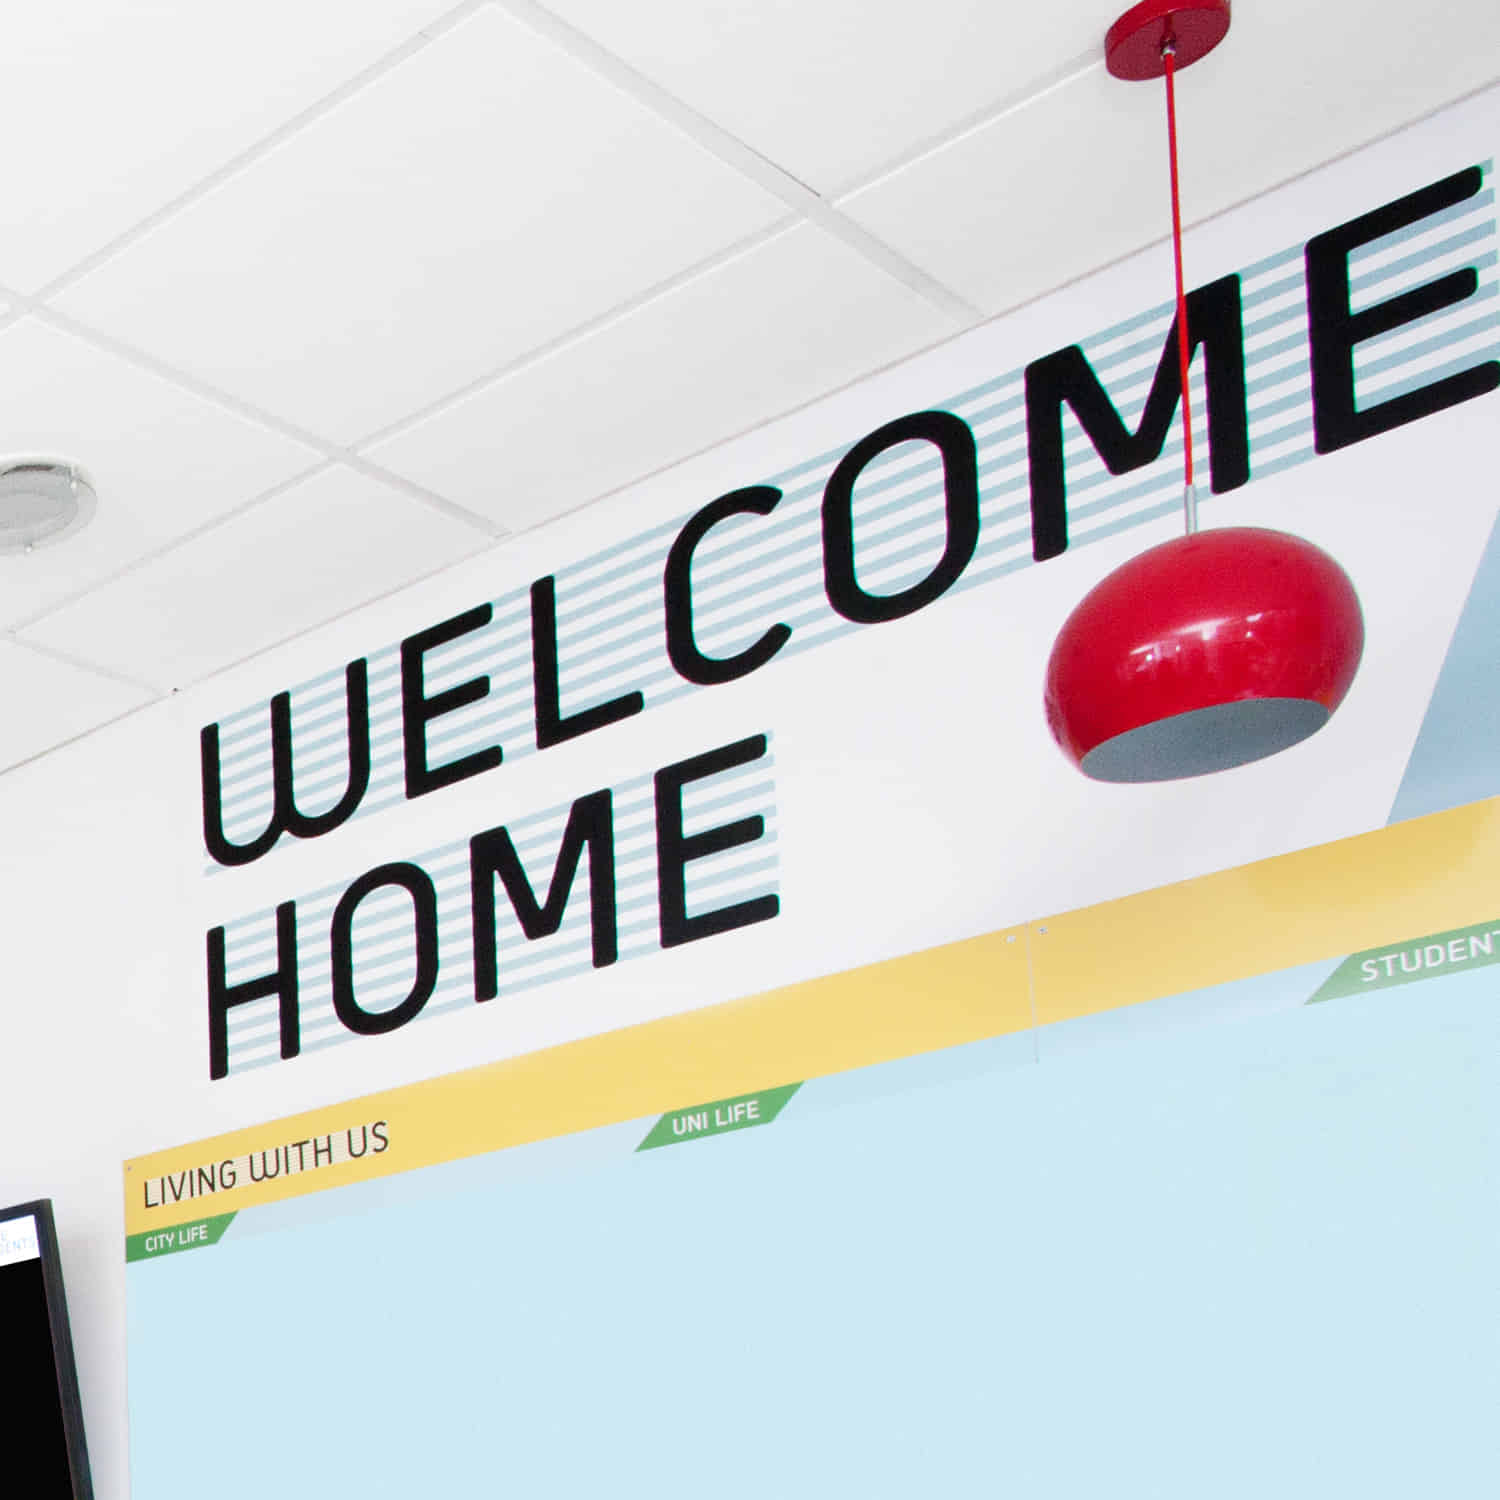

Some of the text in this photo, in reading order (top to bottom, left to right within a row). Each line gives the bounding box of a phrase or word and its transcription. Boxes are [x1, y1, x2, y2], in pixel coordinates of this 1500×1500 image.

[202, 167, 1500, 865] WELCOME
[208, 735, 778, 1080] HOME
[672, 1099, 761, 1136] UNI LIFE
[144, 1120, 389, 1208] LIVING WITH US
[145, 1224, 208, 1252] CITY LIFE
